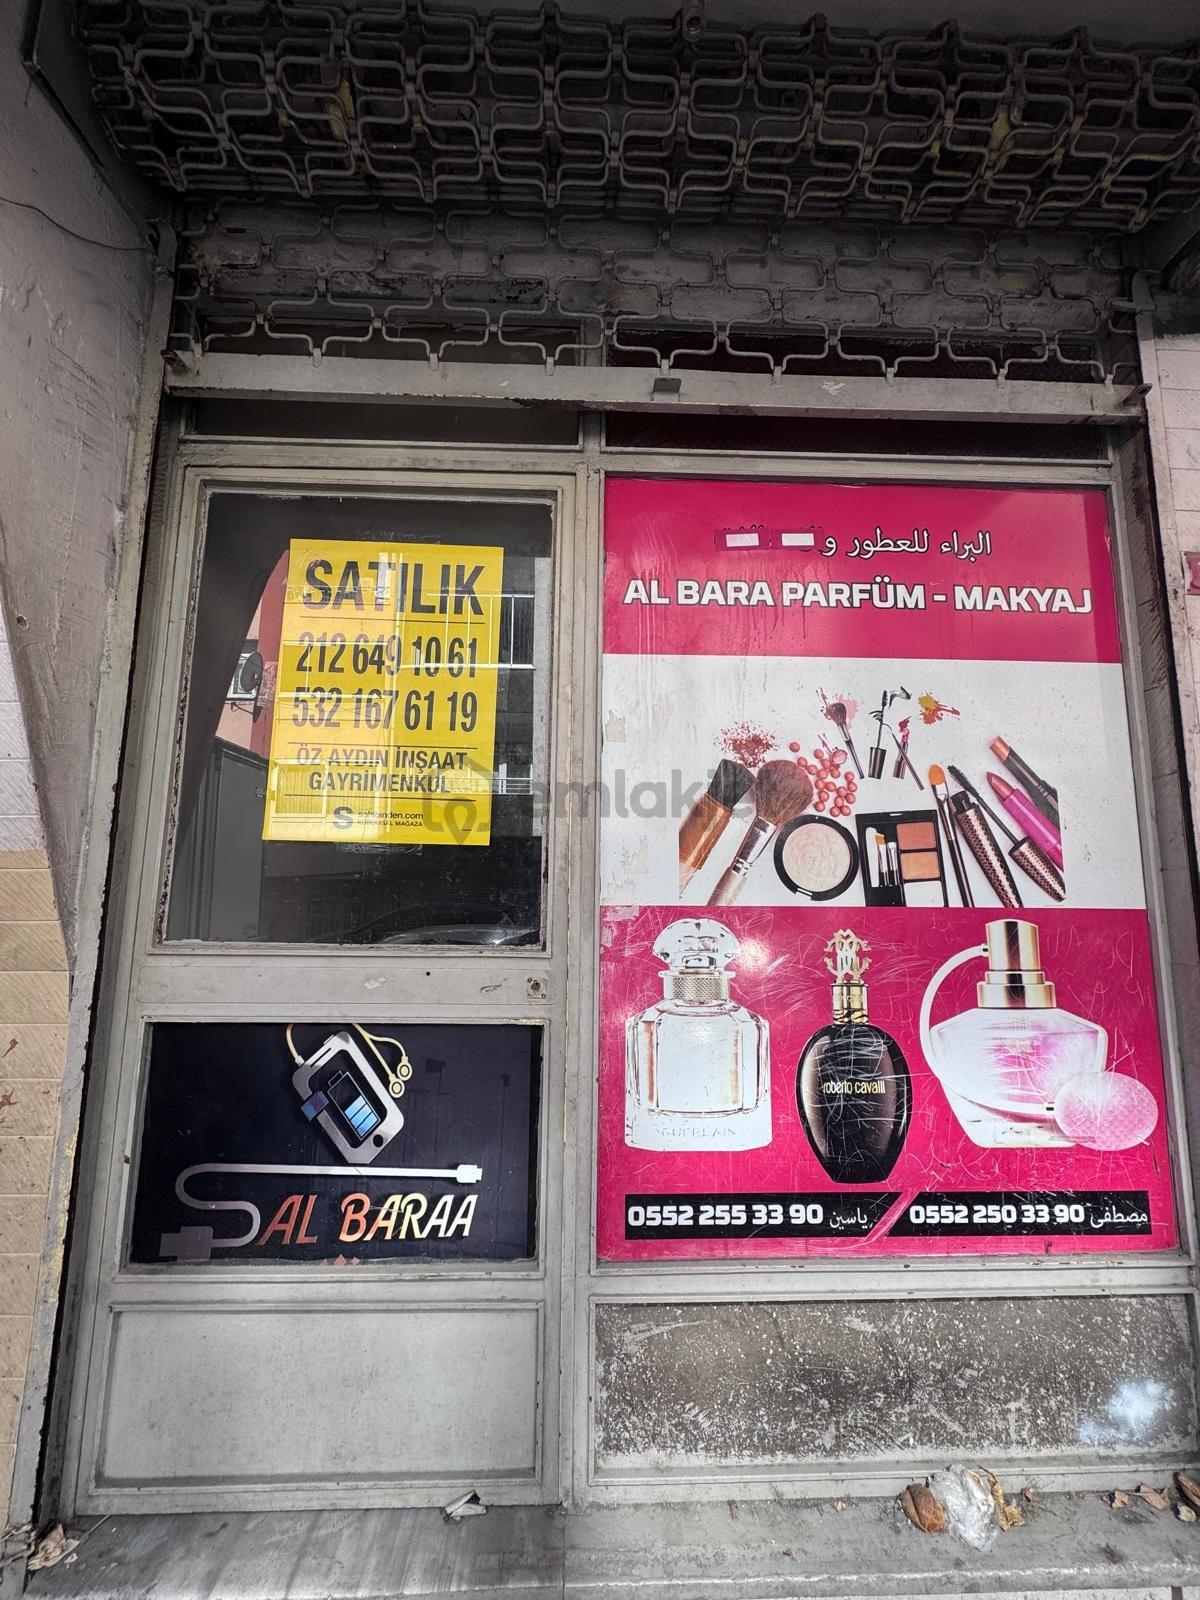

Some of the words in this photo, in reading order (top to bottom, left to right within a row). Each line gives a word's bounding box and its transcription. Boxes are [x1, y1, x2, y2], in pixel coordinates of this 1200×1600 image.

[846, 525, 931, 560] للعطور
[939, 529, 993, 563] البراء
[302, 559, 485, 616] SATILIK
[623, 579, 670, 606] AL
[675, 580, 774, 607] BARA
[782, 575, 925, 610] PARFÜM
[954, 586, 1093, 614] MAKYAJ
[295, 632, 345, 674] 212
[352, 633, 401, 676] 649
[412, 635, 441, 676] 10
[448, 637, 477, 678] 61
[292, 686, 342, 728] 532
[353, 688, 399, 730] 167
[404, 690, 435, 731] 61
[446, 692, 478, 732] 19
[297, 744, 322, 766] ÖZ
[328, 749, 388, 767] AYDIN
[309, 769, 450, 794] GAYRİMENKUL
[395, 819, 423, 827] MAĞAZA
[823, 1081, 852, 1094] roberto
[258, 1194, 318, 1246] AL
[338, 1192, 479, 1243] BARAA
[627, 1205, 694, 1226] 0552
[698, 1205, 747, 1225] 255
[752, 1205, 784, 1225] 33
[789, 1204, 824, 1224] 90
[829, 1208, 868, 1229] ياسين
[909, 1205, 969, 1224] 0552
[972, 1205, 1017, 1224] 250
[1021, 1205, 1050, 1223] 33
[1053, 1204, 1085, 1223] 90
